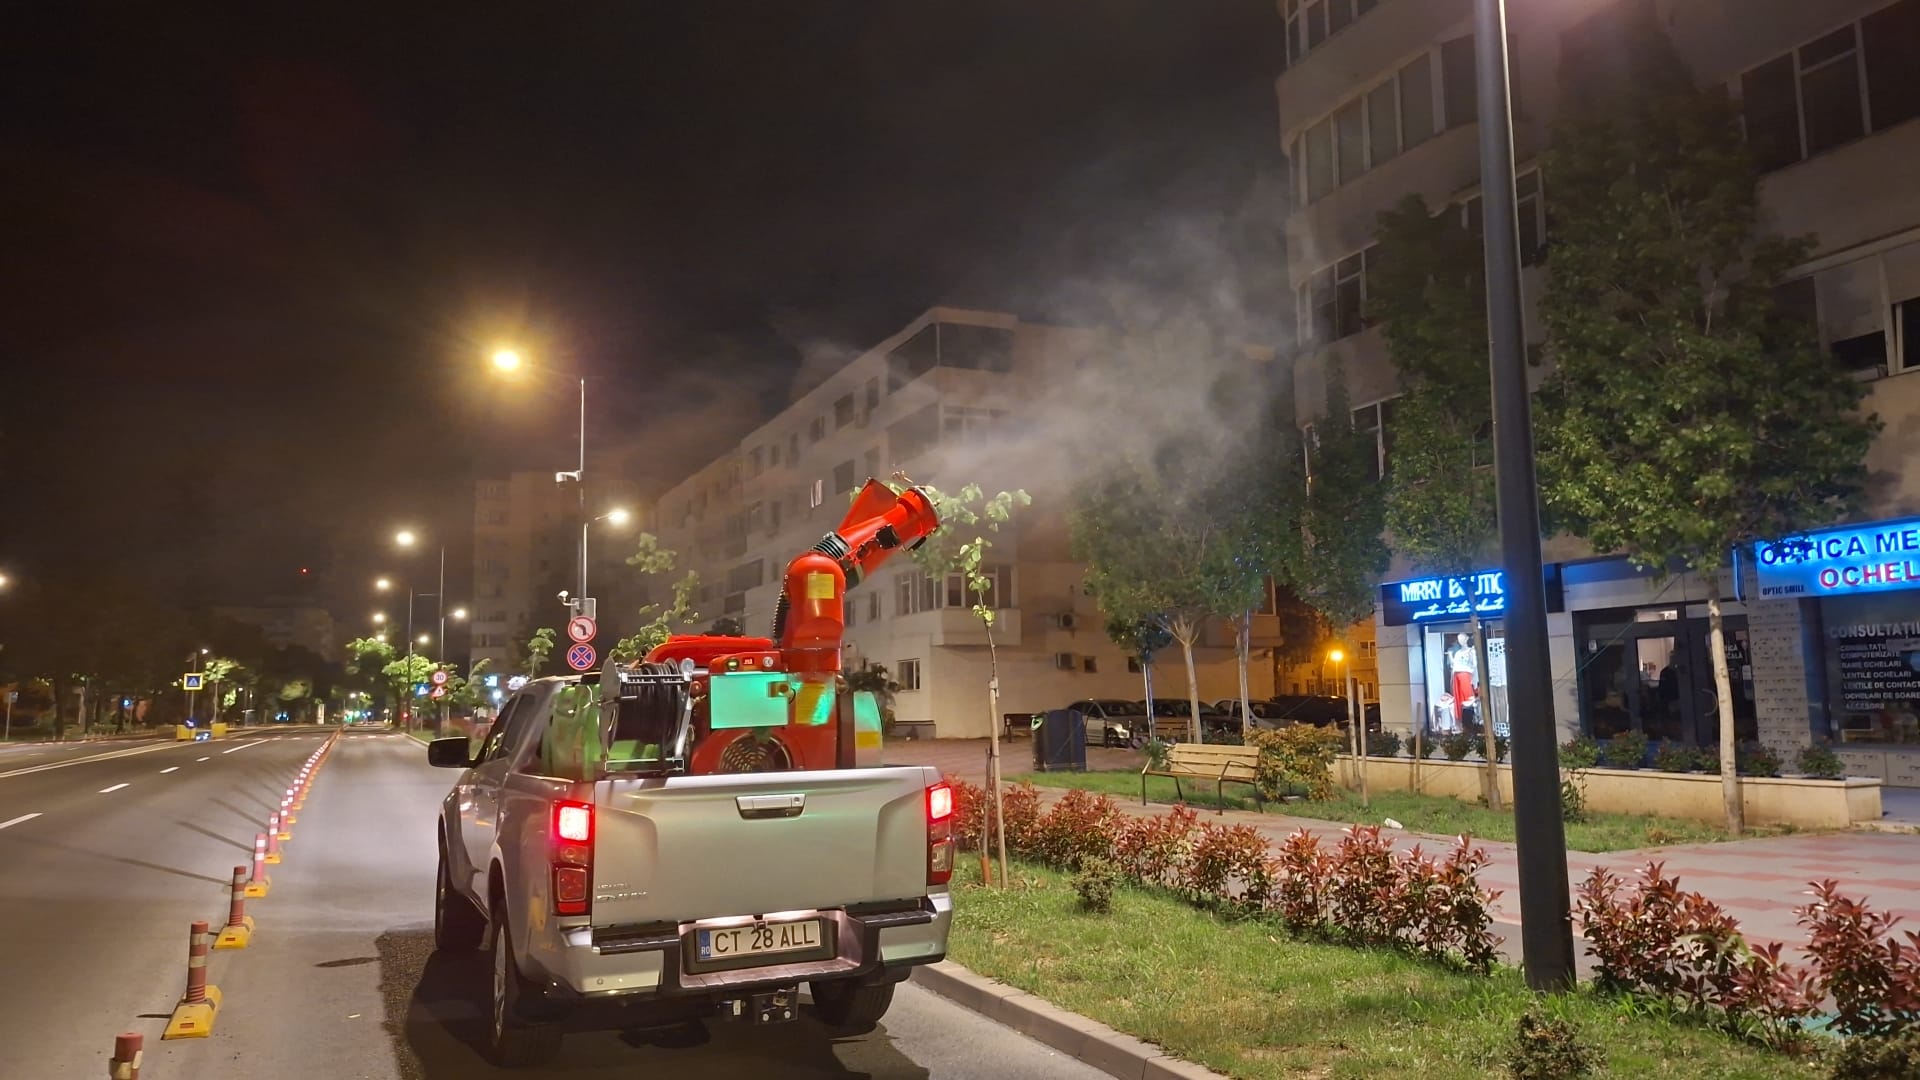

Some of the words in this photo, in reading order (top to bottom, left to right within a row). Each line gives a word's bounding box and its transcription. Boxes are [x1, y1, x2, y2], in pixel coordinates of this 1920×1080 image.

[1401, 580, 1443, 602] MIRRY
[1762, 586, 1783, 596] OPTIC
[1873, 670, 1912, 678] OCHELARI
[1874, 681, 1885, 689] DE
[715, 930, 741, 953] CT
[750, 928, 774, 950] 28
[780, 923, 815, 947] ALL
[701, 946, 711, 955] RO
